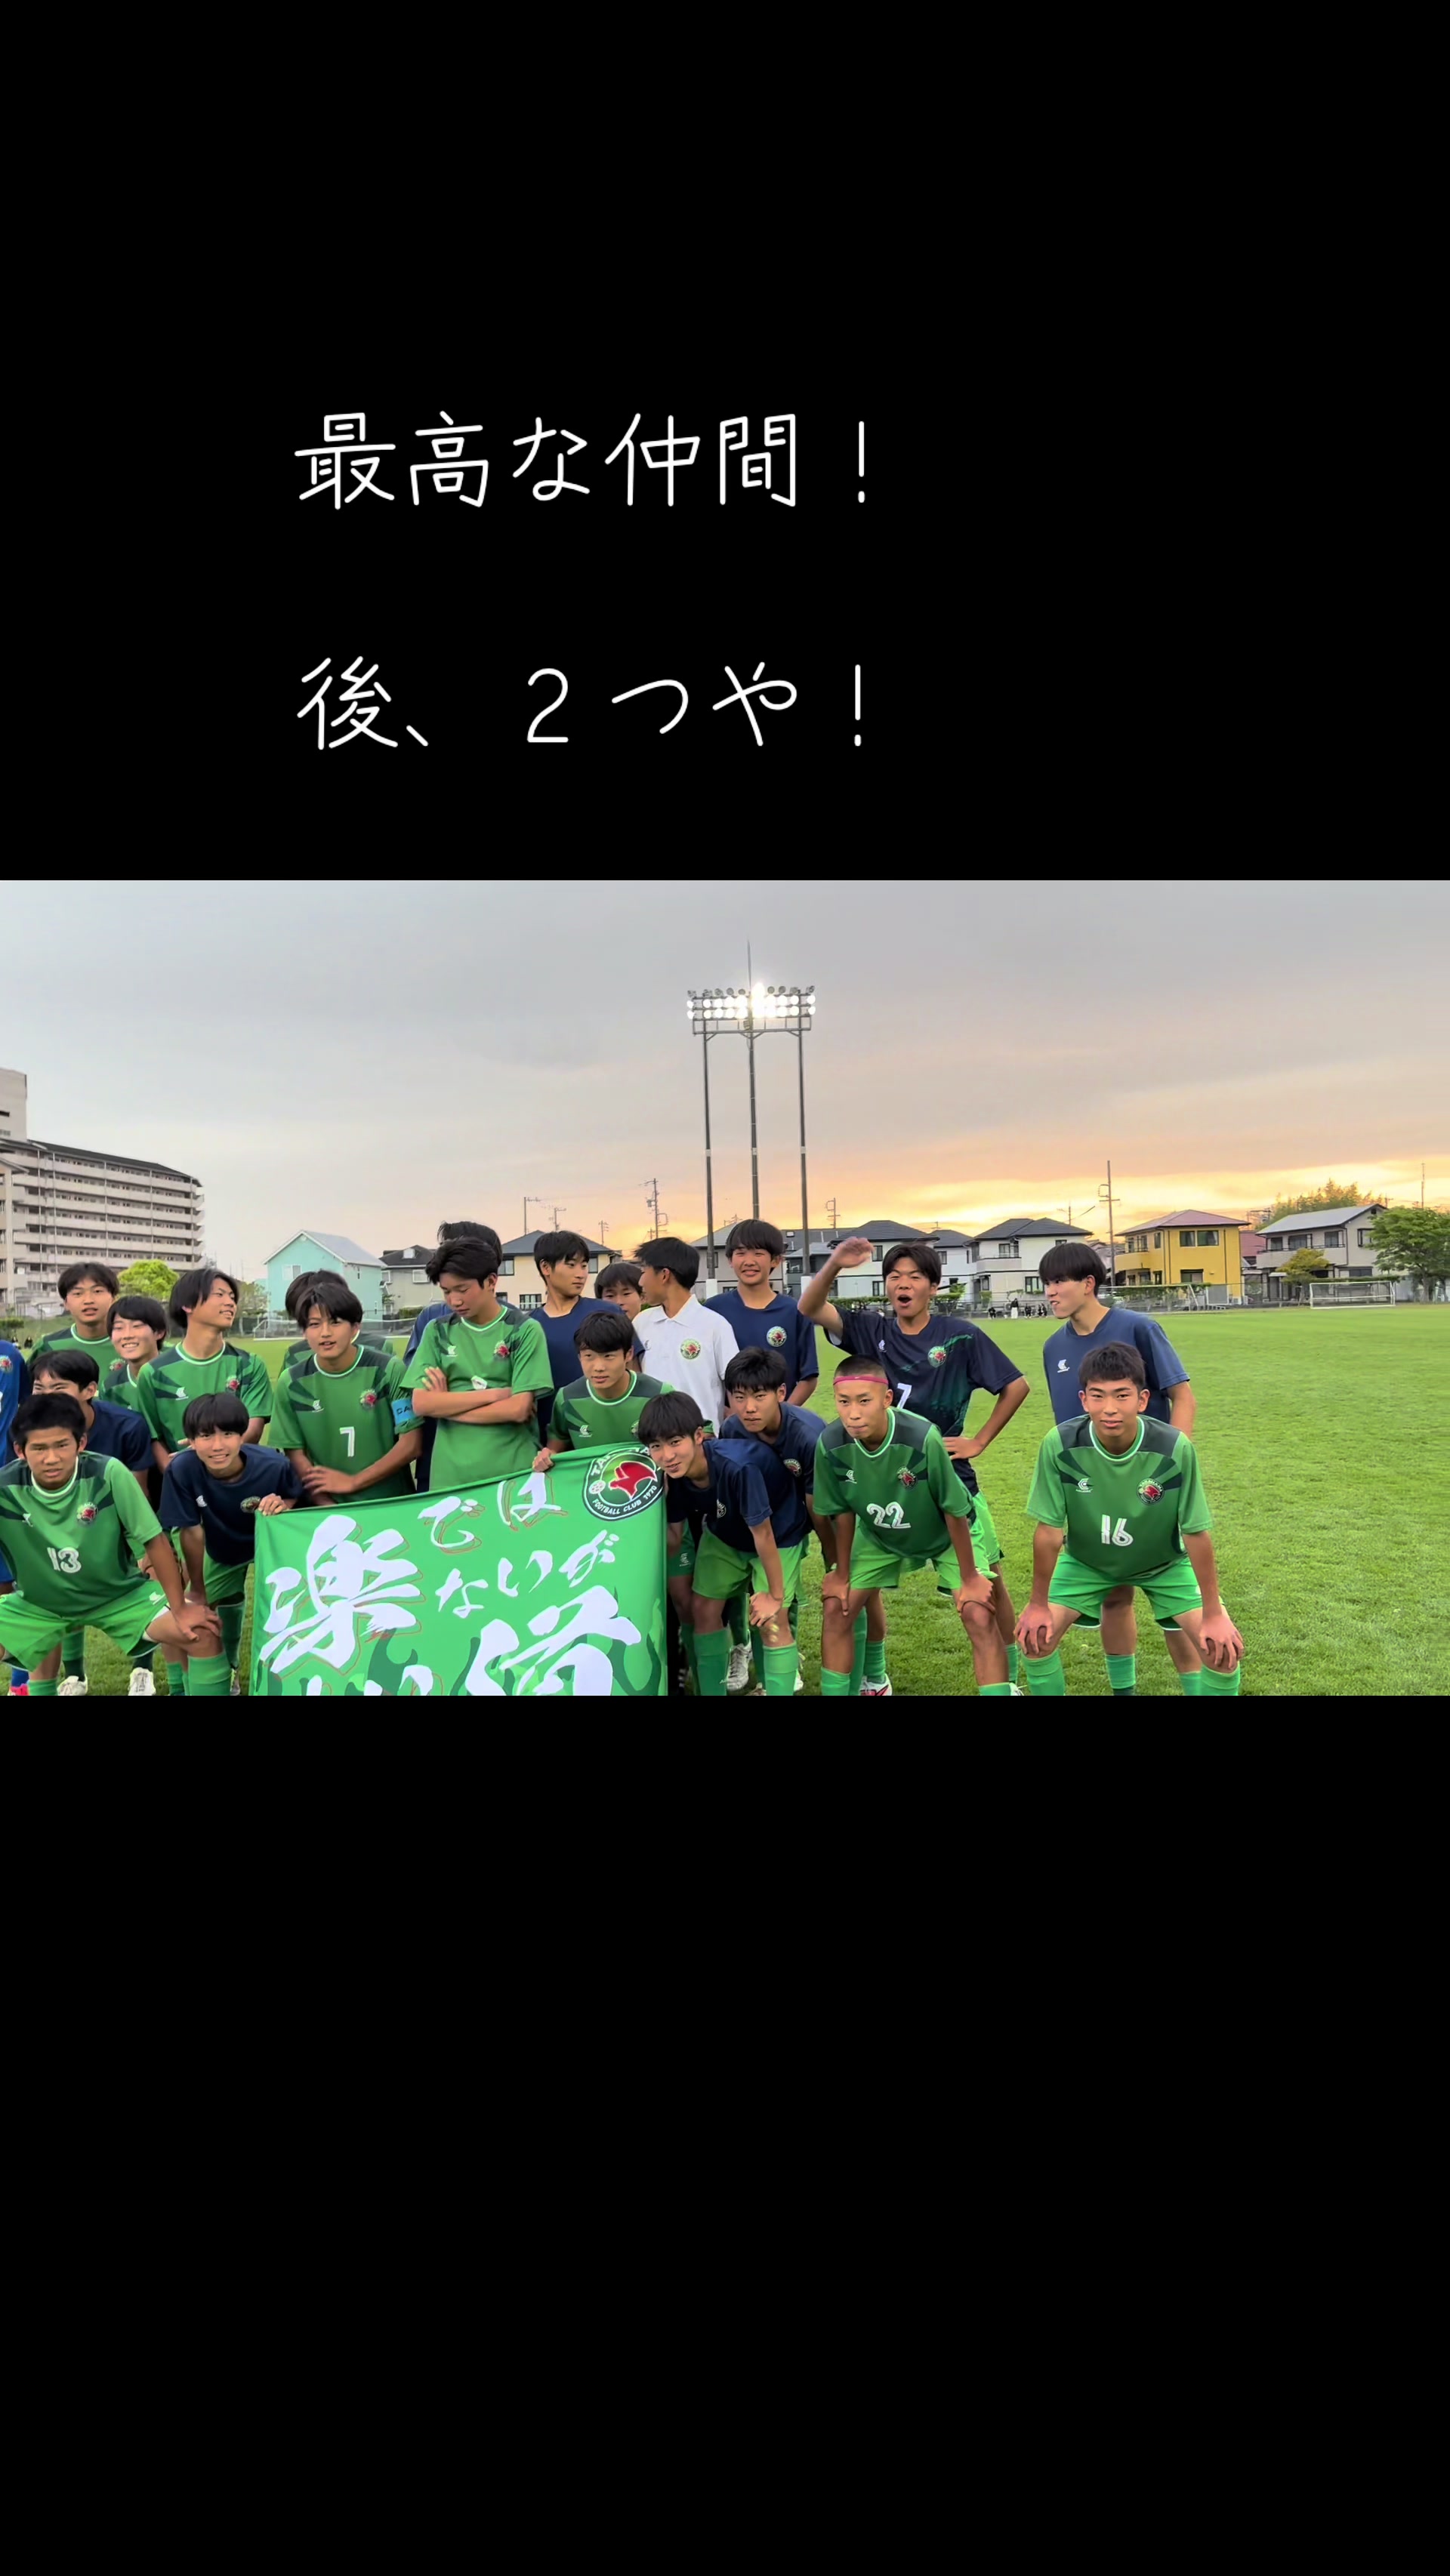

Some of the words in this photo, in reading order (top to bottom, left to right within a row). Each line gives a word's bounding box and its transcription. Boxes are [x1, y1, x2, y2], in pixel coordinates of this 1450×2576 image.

[896, 1382, 912, 1410] 7
[339, 1426, 355, 1457] 7
[418, 1471, 561, 1548] では
[592, 1498, 621, 1515] FOOTBALL
[623, 1499, 642, 1512] CLUB
[643, 1485, 657, 1500] 1970
[866, 1501, 912, 1529] 22
[1101, 1514, 1134, 1547] 16
[47, 1546, 82, 1573] 13
[435, 1529, 620, 1619] ないが
[258, 1514, 422, 1675] 楽
